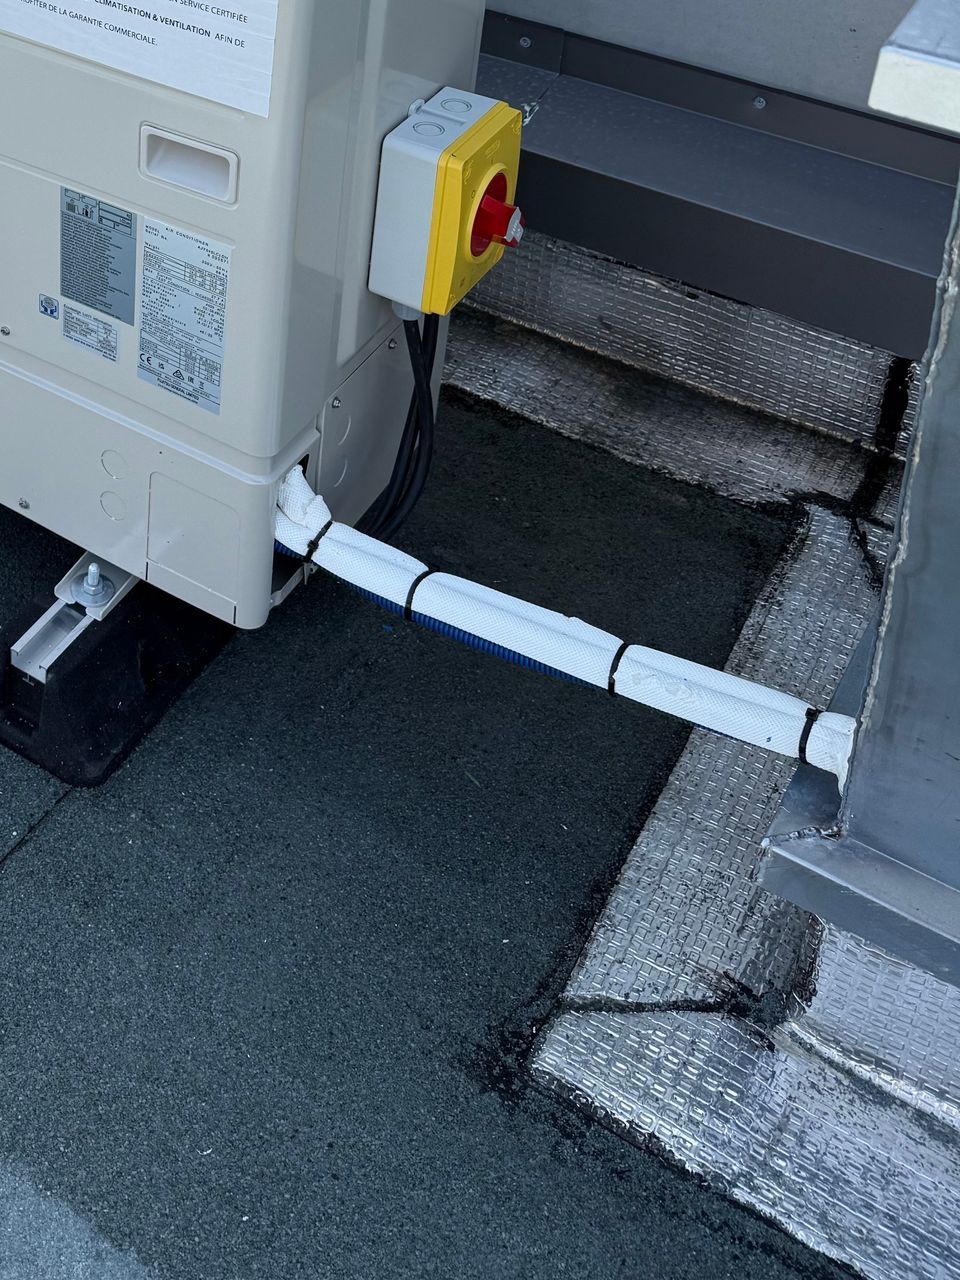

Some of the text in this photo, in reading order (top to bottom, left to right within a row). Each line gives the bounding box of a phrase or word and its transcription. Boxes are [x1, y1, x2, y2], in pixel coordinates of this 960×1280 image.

[48, 3, 57, 13] DE
[58, 7, 67, 15] LA
[68, 10, 102, 28] GARANTIE
[103, 22, 157, 45] COMMERCIALE.
[152, 13, 158, 21] &
[159, 15, 210, 37] VENTILATION
[214, 32, 232, 44] AFIN
[234, 38, 245, 48] DE
[210, 6, 247, 23] CERTIFIÉE
